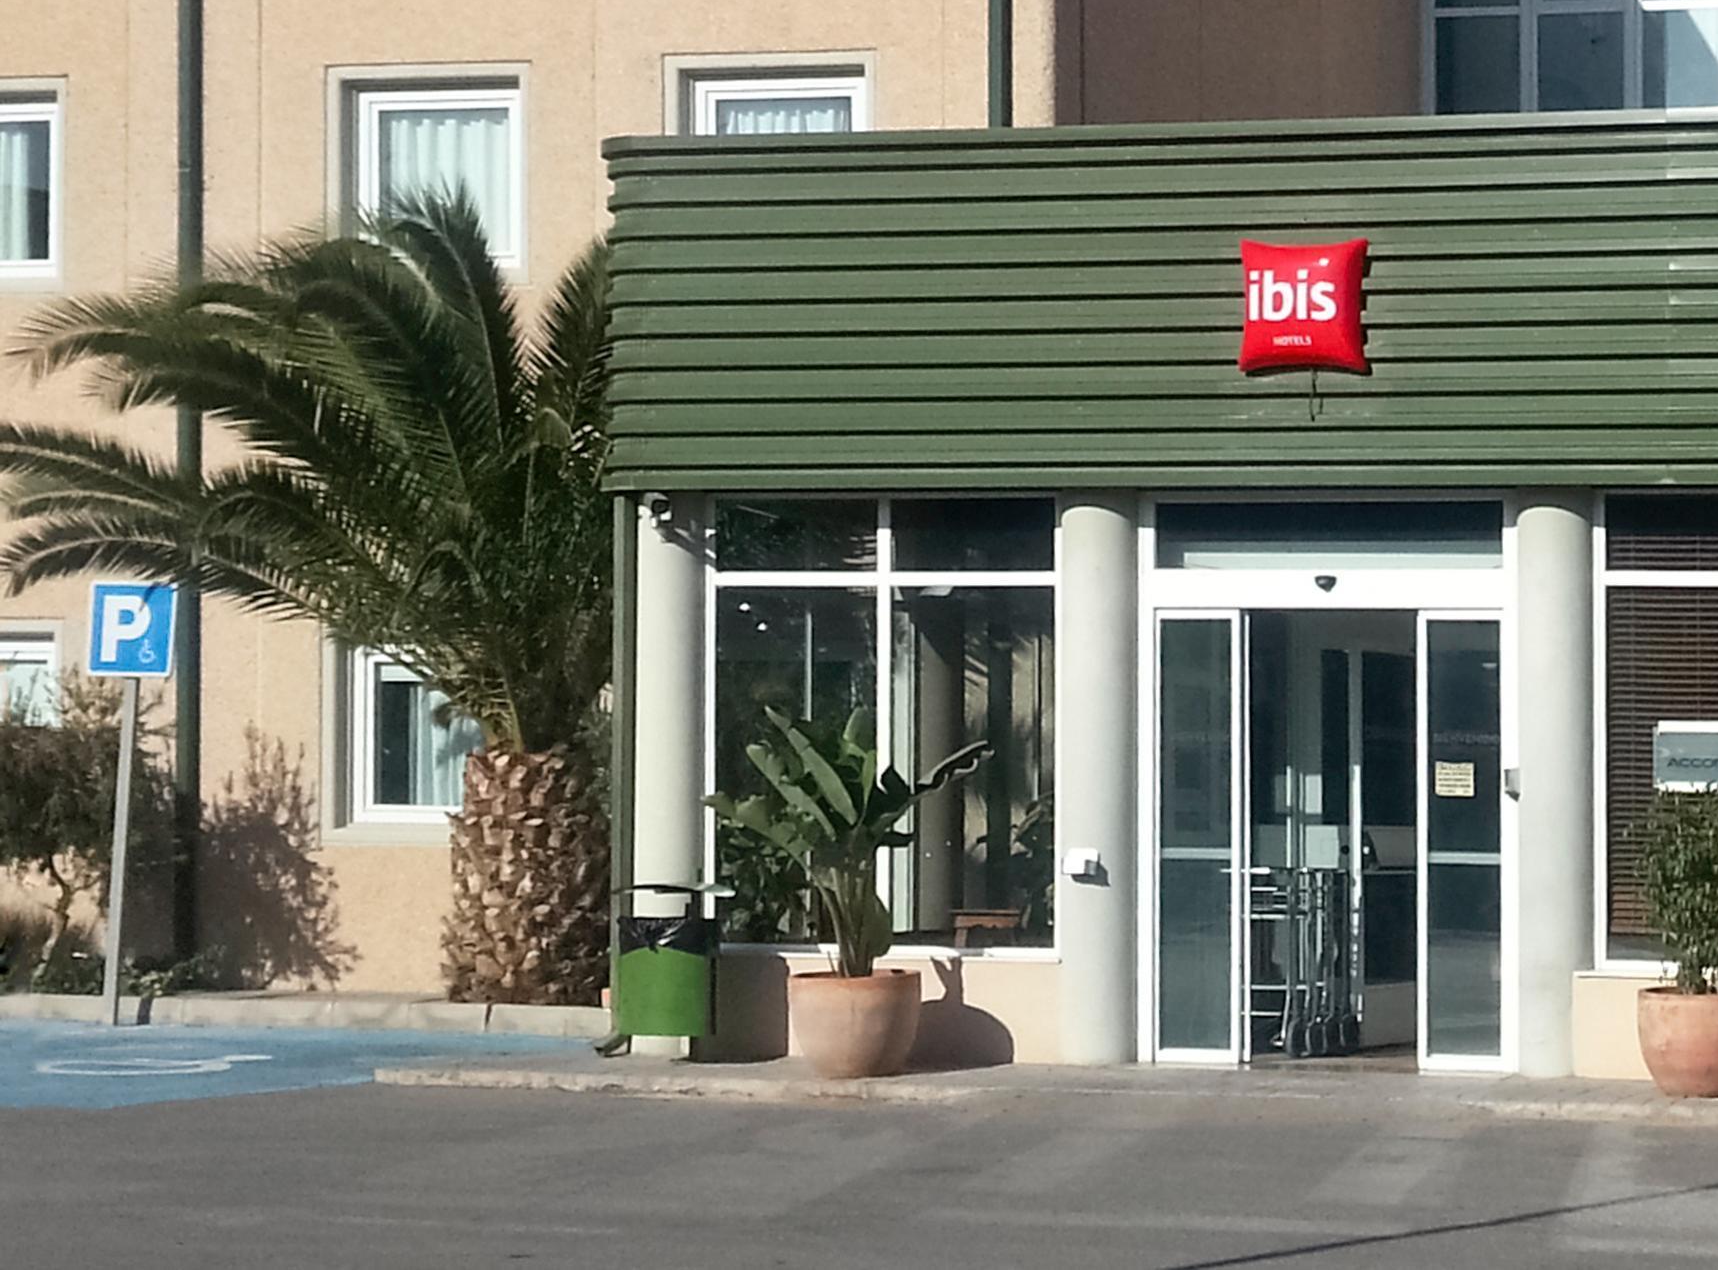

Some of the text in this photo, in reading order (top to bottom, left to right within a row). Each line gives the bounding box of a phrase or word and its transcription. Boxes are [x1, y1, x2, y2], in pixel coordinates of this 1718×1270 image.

[1248, 268, 1338, 322] ibis
[1272, 334, 1313, 347] HOTELS
[100, 594, 152, 663] P
